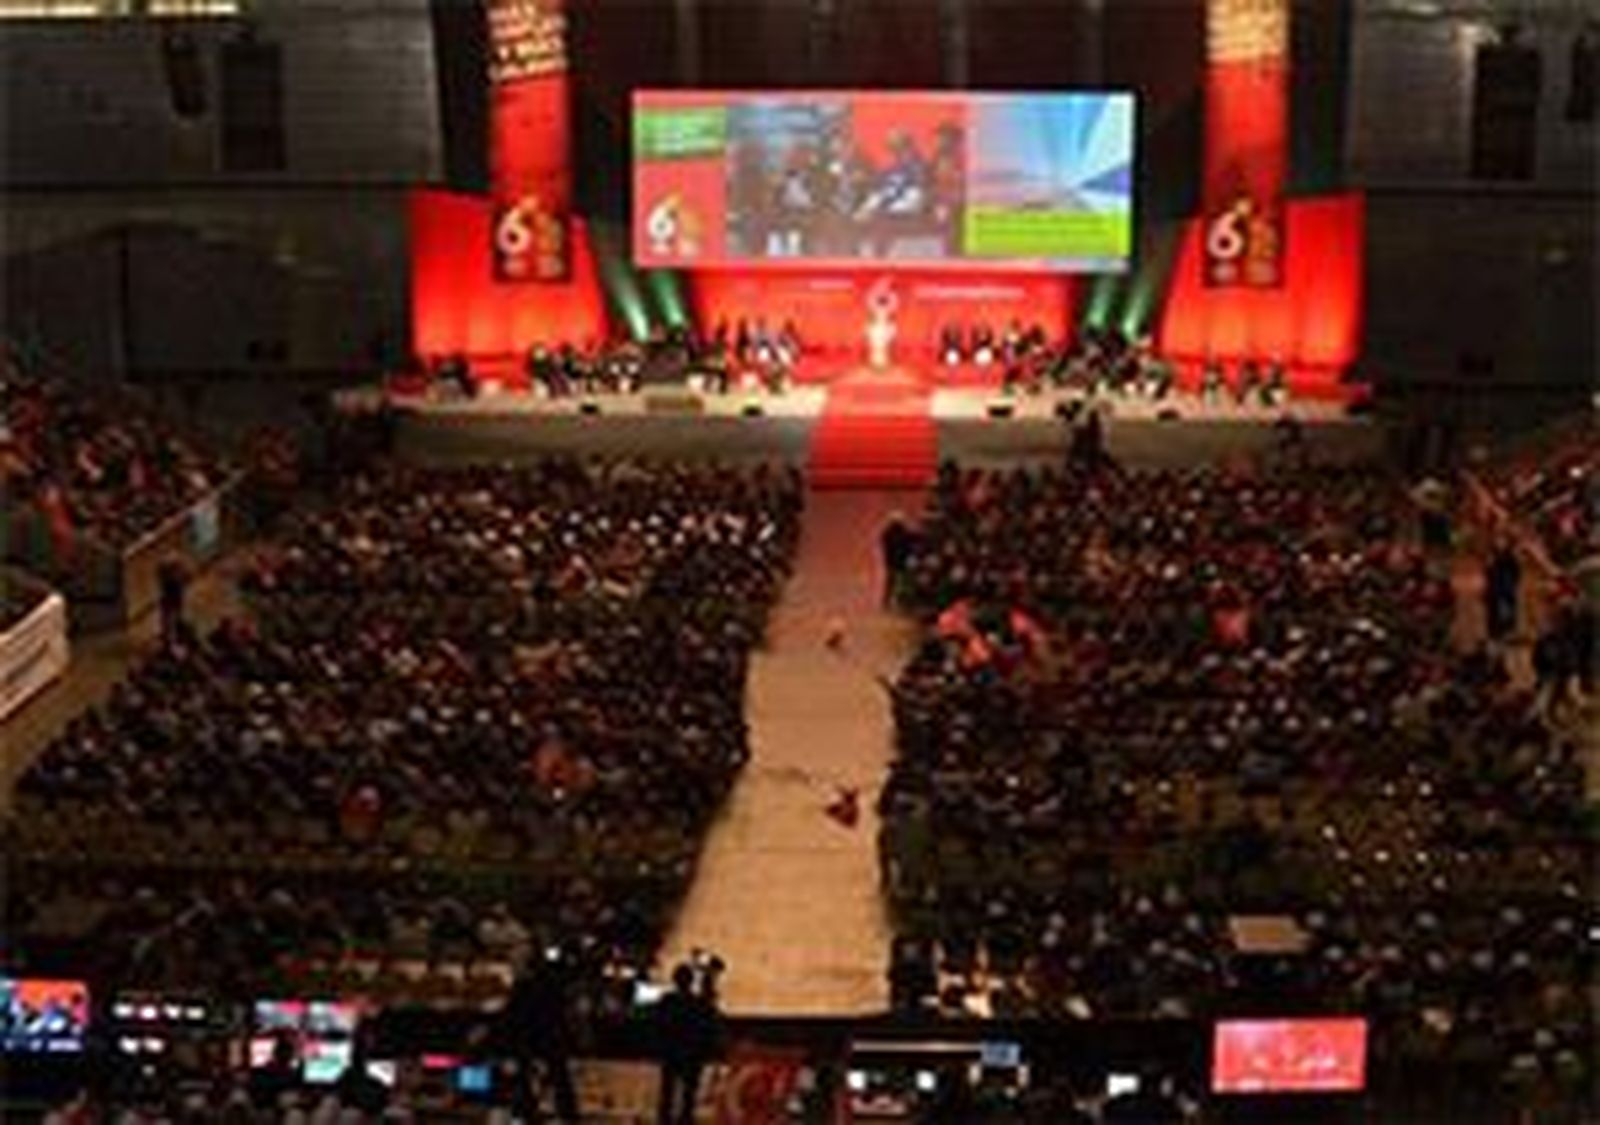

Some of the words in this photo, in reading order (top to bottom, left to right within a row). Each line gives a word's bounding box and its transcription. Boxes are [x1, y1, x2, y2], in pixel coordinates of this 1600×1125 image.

[497, 198, 536, 253] 6
[648, 191, 680, 241] 6
[1207, 201, 1250, 260] 6
[866, 275, 898, 313] 6
